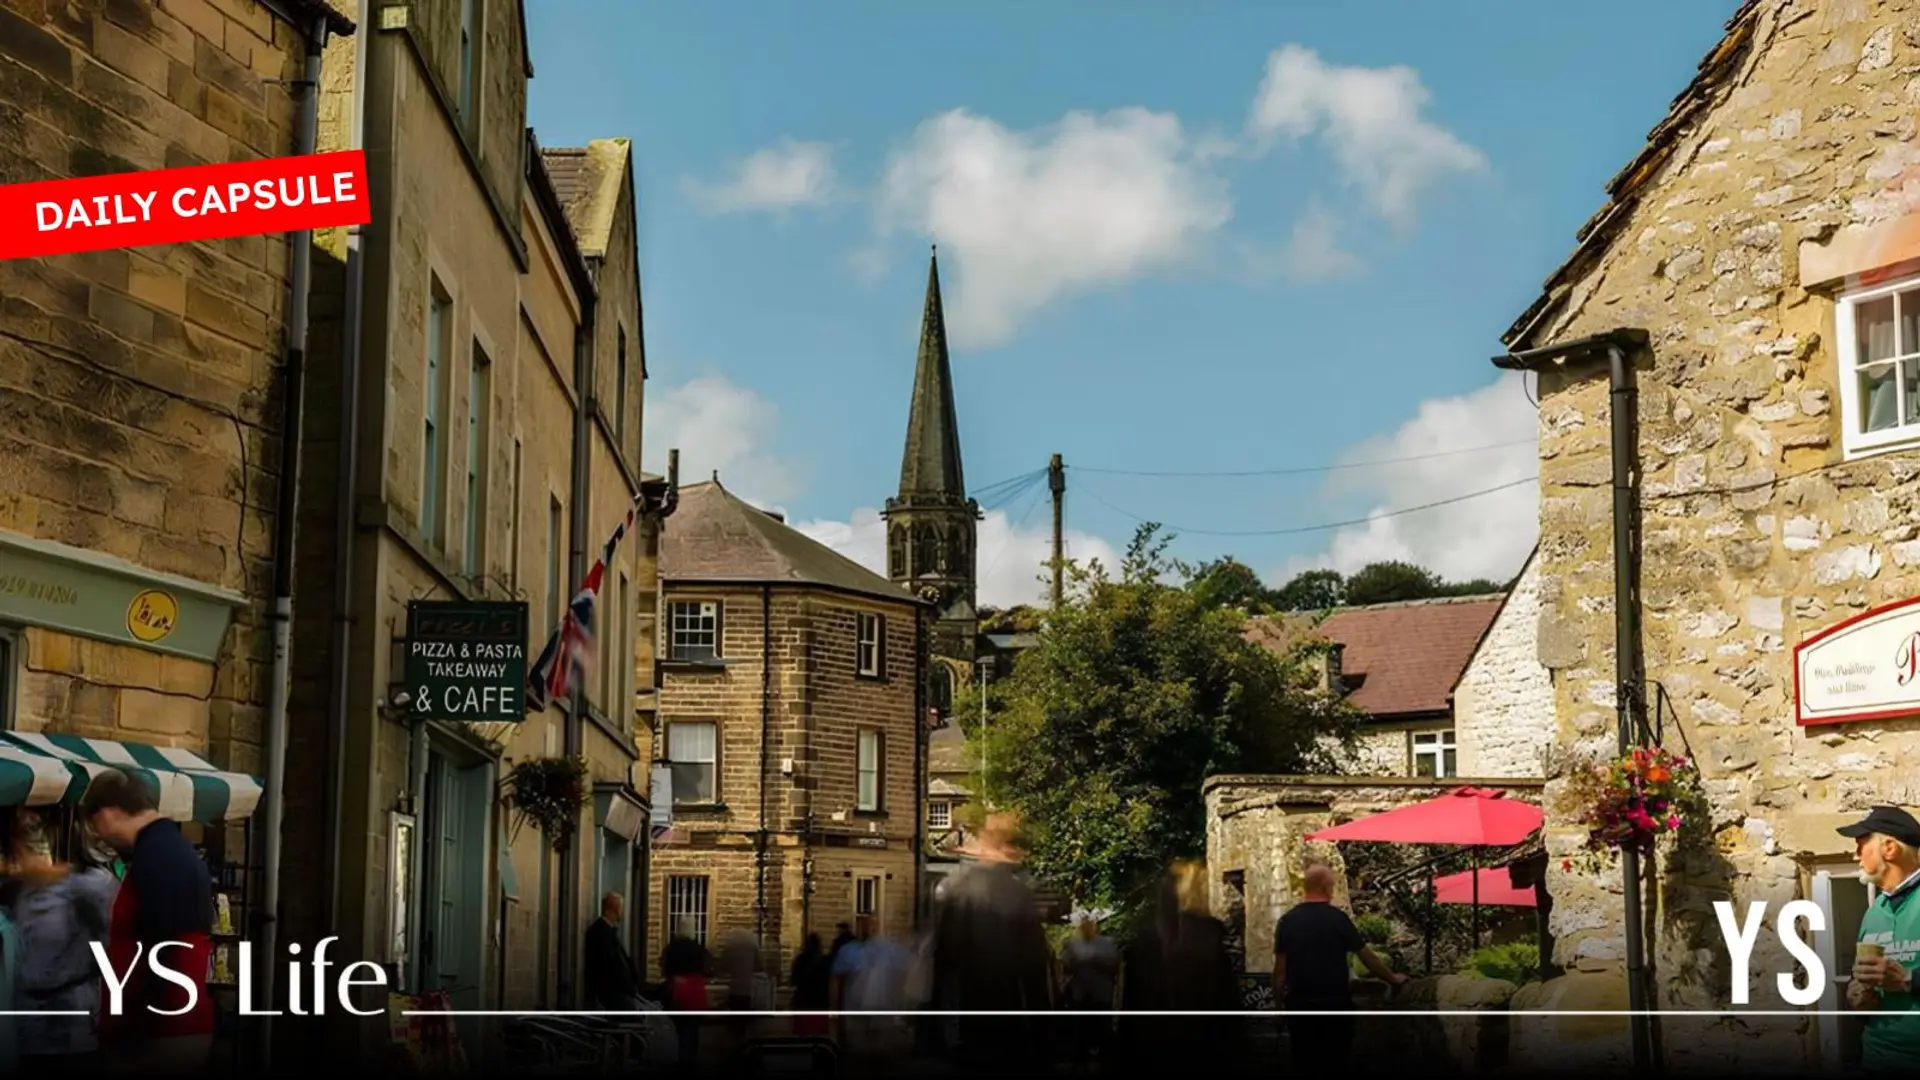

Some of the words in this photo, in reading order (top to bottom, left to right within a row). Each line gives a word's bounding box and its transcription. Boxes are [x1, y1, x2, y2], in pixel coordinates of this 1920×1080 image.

[412, 641, 456, 658] PIZZA
[460, 642, 470, 658] &
[475, 644, 522, 659] PASTA
[427, 662, 507, 679] TAKEAWAY
[416, 684, 433, 713] &
[443, 685, 515, 714] CAFE
